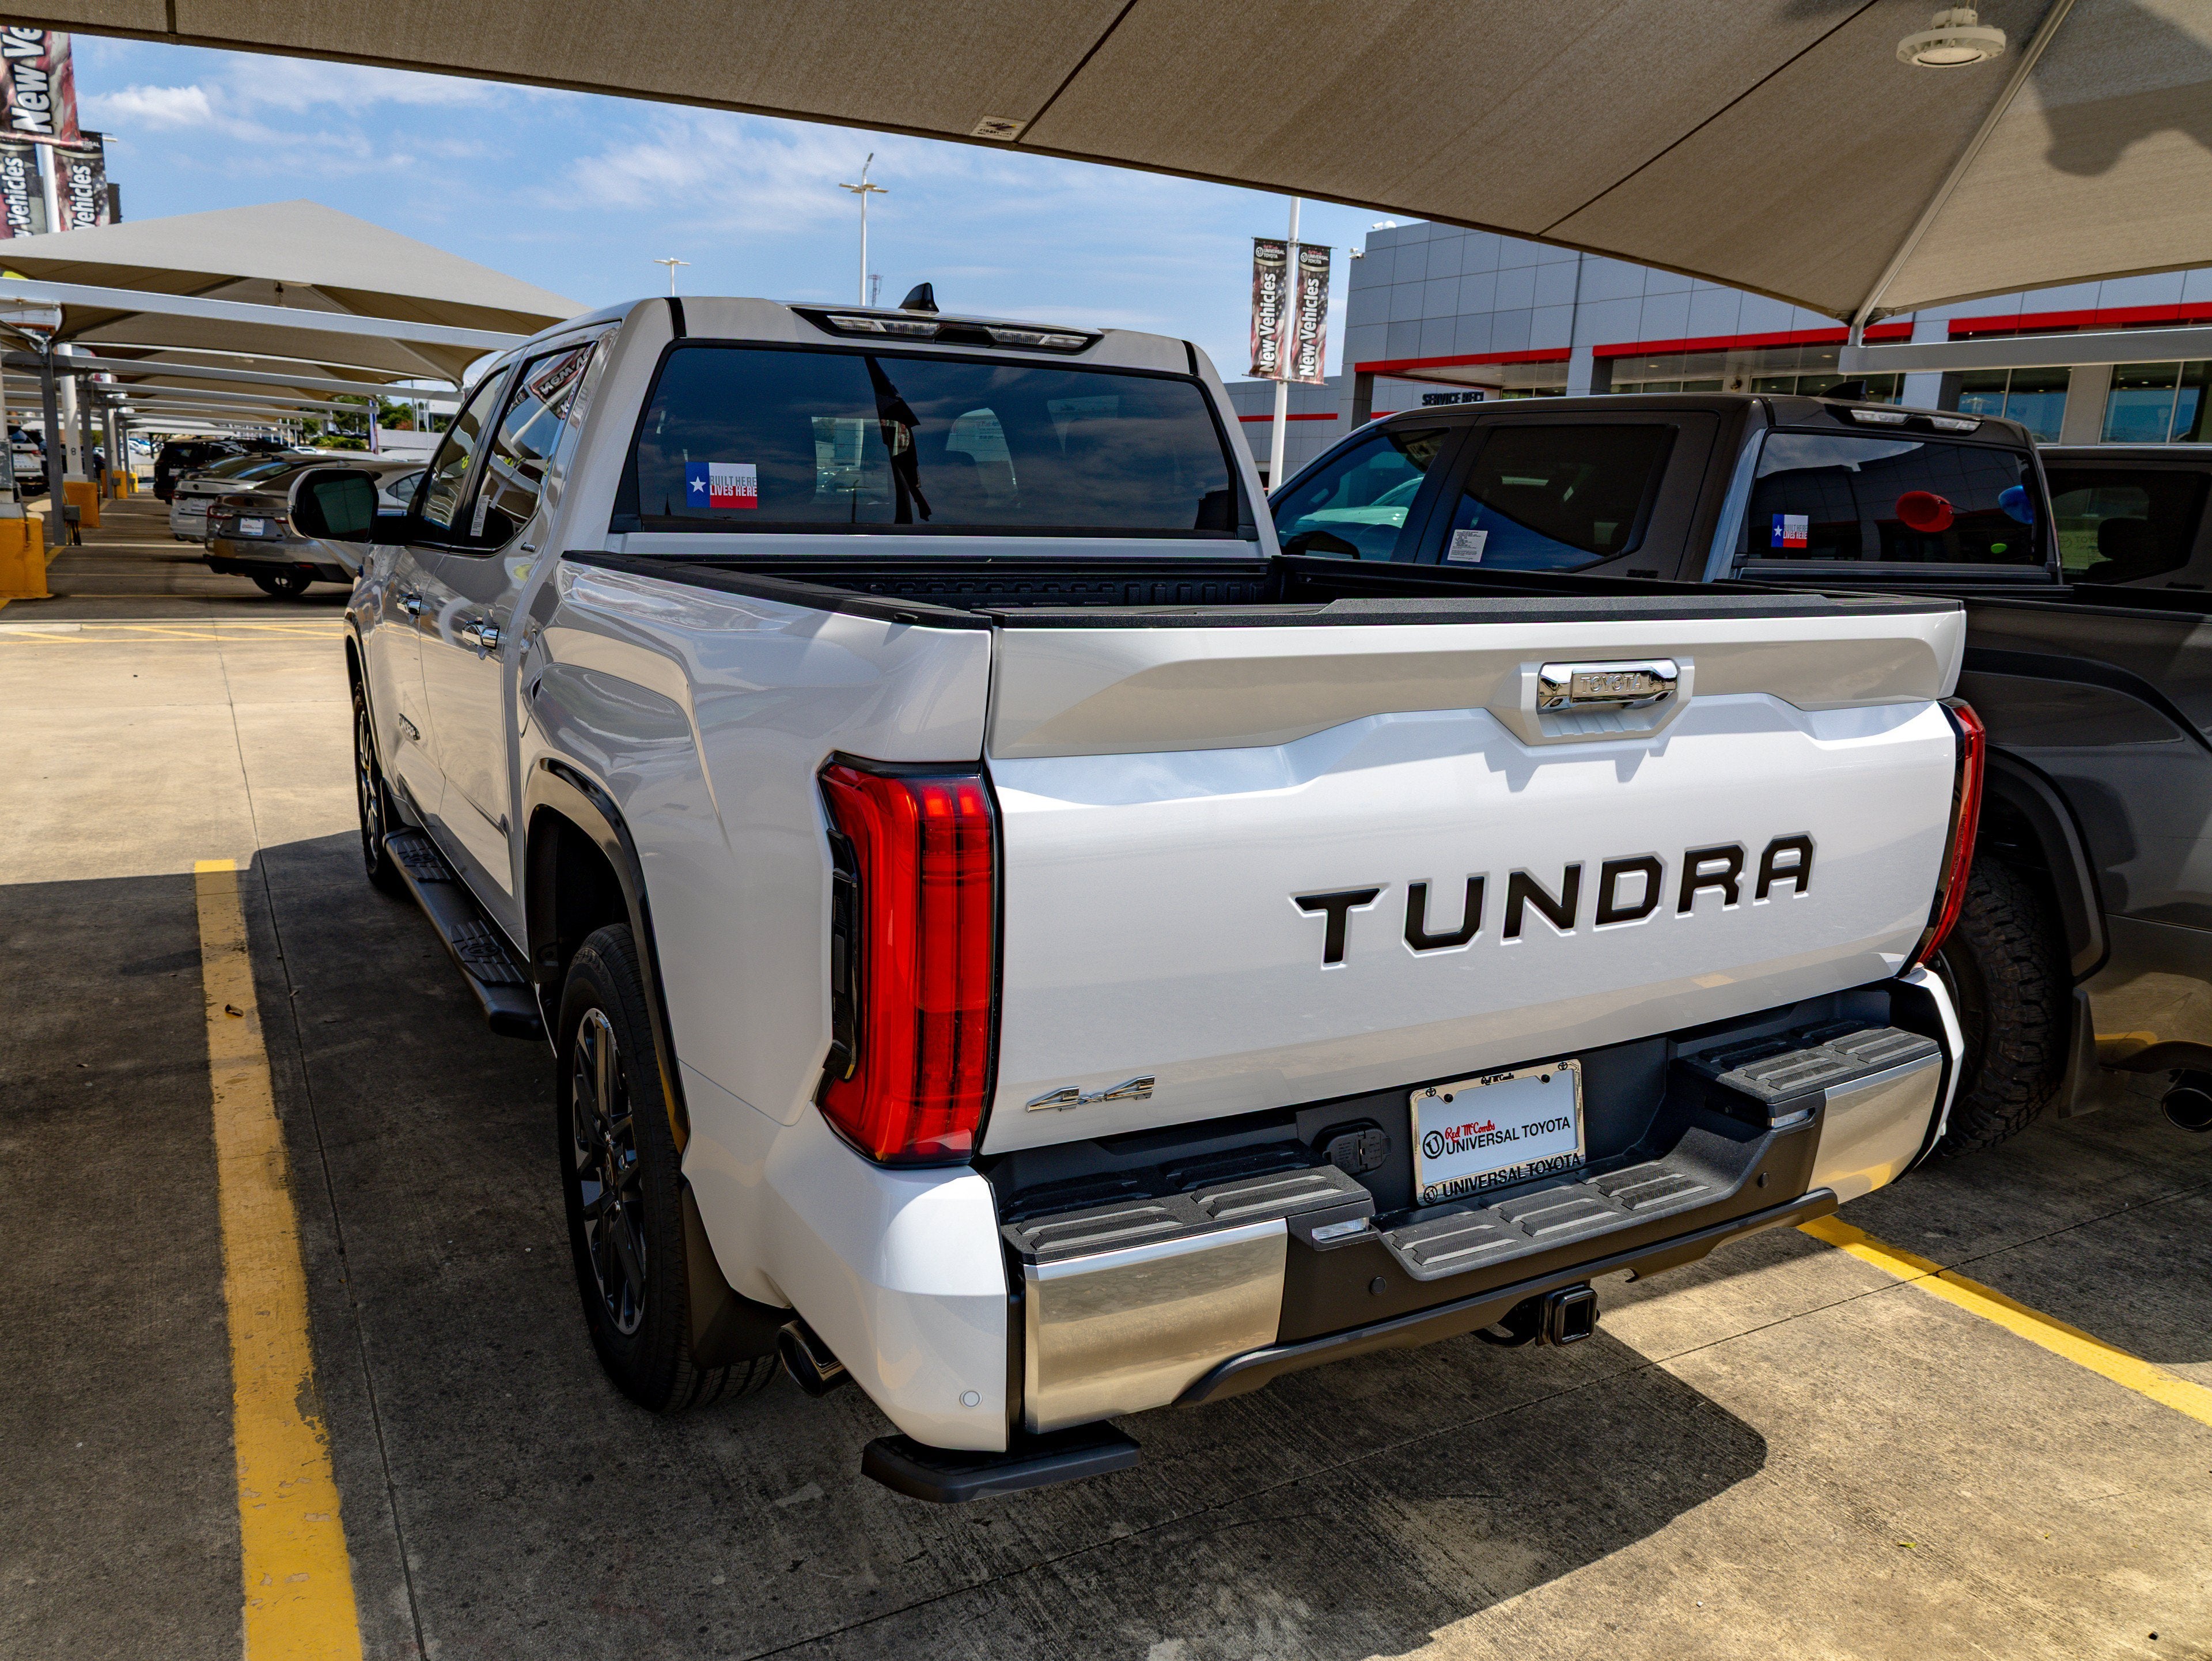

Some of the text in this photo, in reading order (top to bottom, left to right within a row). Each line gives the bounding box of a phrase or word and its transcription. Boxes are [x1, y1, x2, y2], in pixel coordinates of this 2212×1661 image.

[10, 64, 54, 134] New
[2, 157, 31, 225] Vehicles
[1259, 273, 1277, 373] New Vehicles
[1299, 278, 1319, 377] New Vehicles
[1422, 393, 1461, 406] SERVICE
[709, 475, 757, 487] BUILT HERE
[710, 485, 757, 497] LIVES HERE
[1580, 673, 1644, 694] TOYOTA
[1291, 832, 1815, 967] TUNDRA
[1445, 1119, 1495, 1144] Red McCombs
[1446, 1127, 1520, 1155] UNIVERSAL
[1521, 1117, 1571, 1137] TOYOTA
[1442, 1166, 1526, 1198] UNIVERSAL
[1526, 1152, 1582, 1177] TOYOTA
